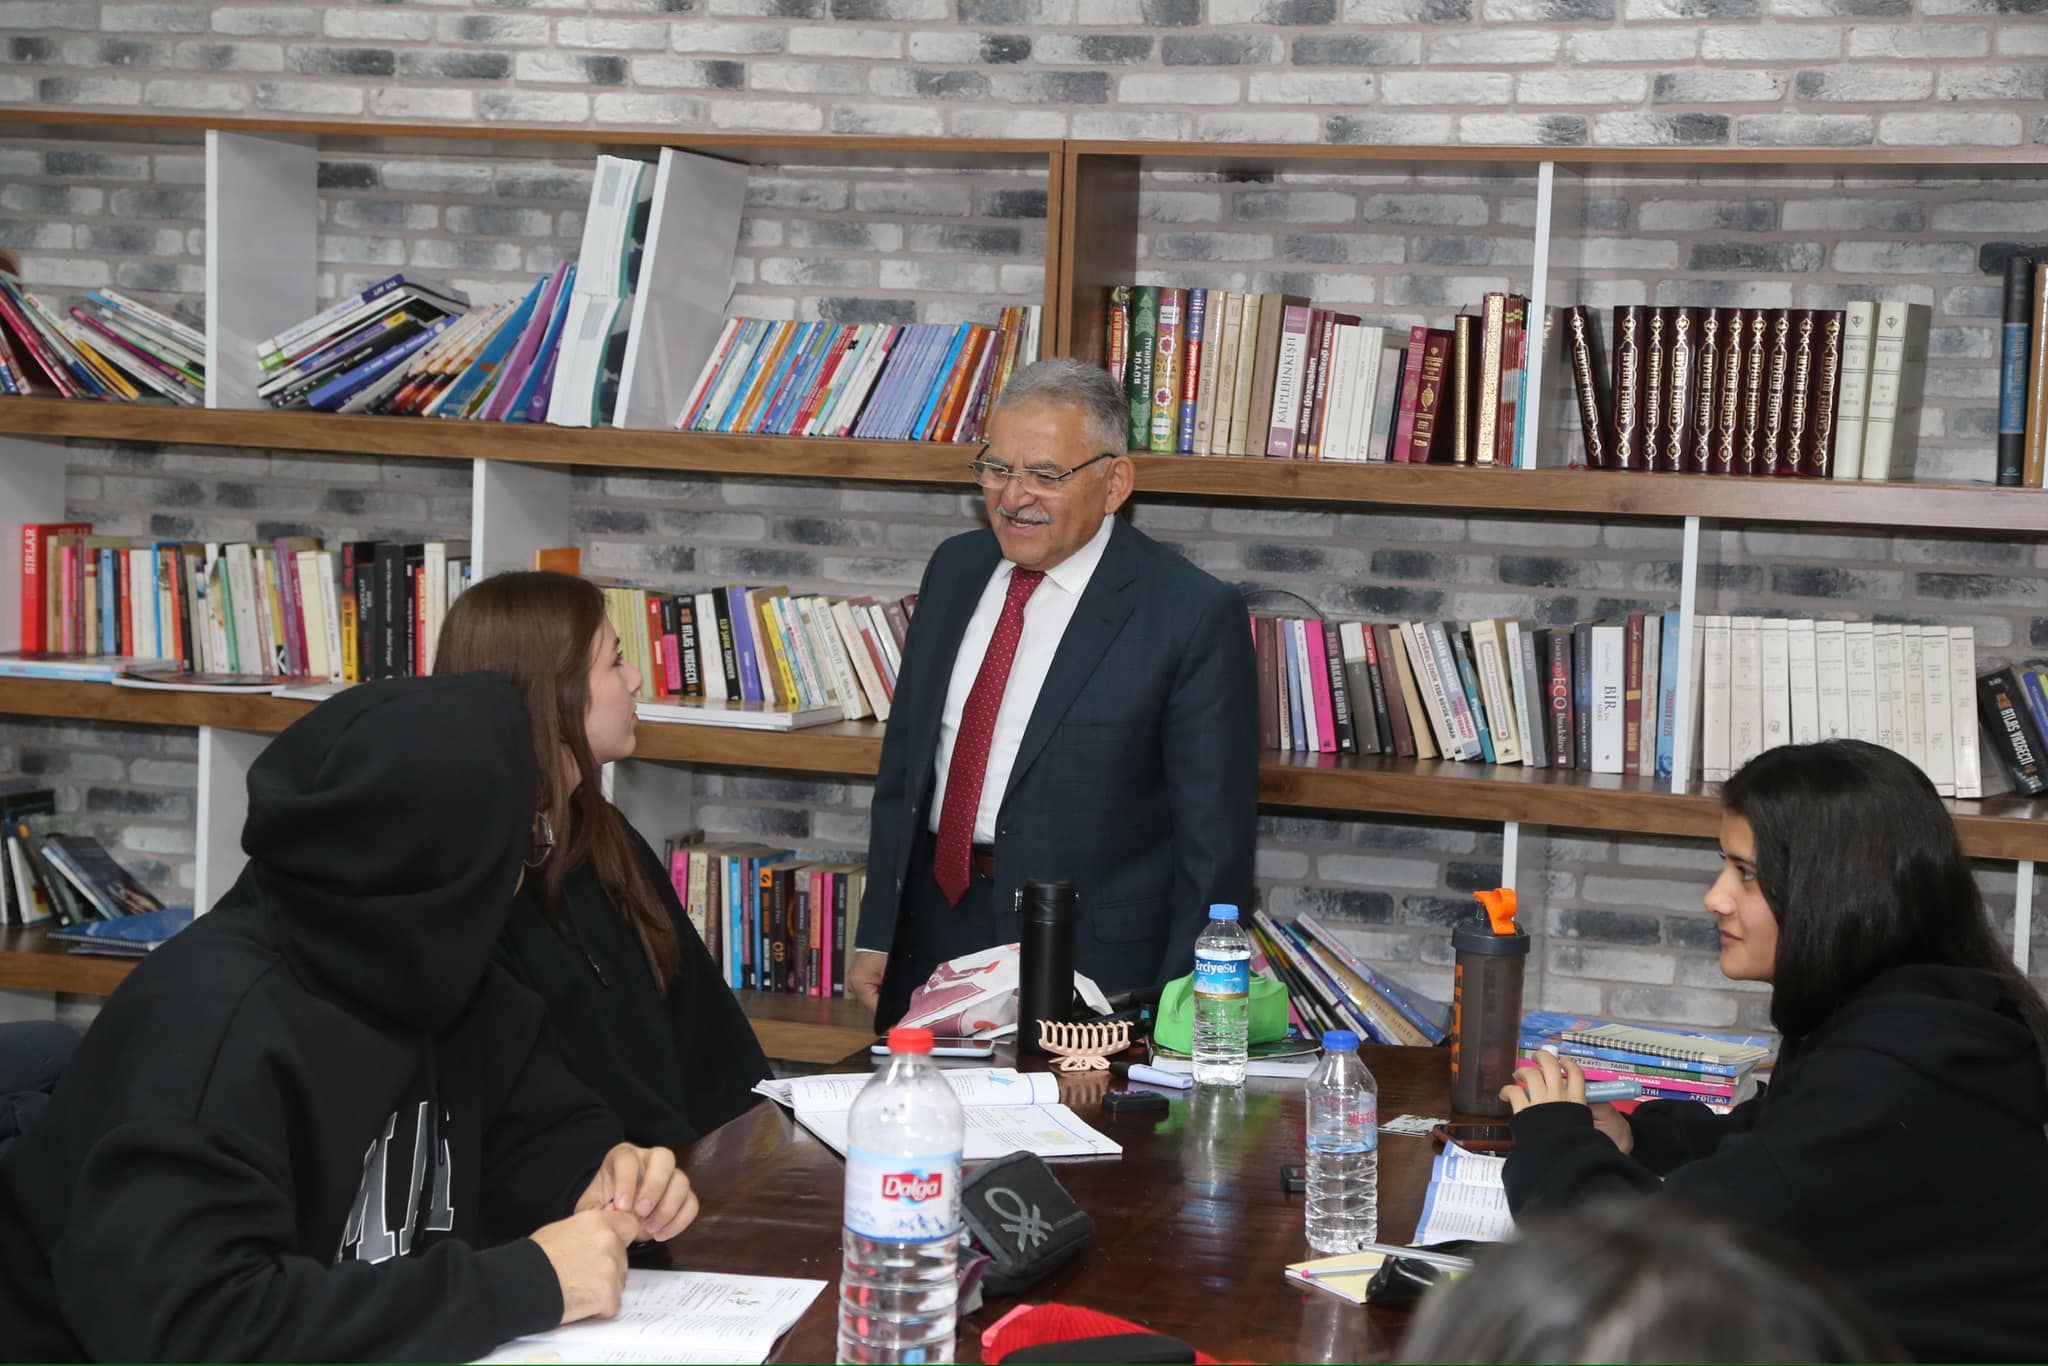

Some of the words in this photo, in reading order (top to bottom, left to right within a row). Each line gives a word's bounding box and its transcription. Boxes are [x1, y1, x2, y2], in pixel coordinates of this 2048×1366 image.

[1133, 351, 1142, 384] BÜYÜK
[1329, 657, 1343, 685] HAKAN
[1553, 677, 1568, 710] ECO
[1605, 686, 1618, 710] BİR
[2000, 708, 2020, 732] ATLAS
[884, 1177, 940, 1201] Dalga
